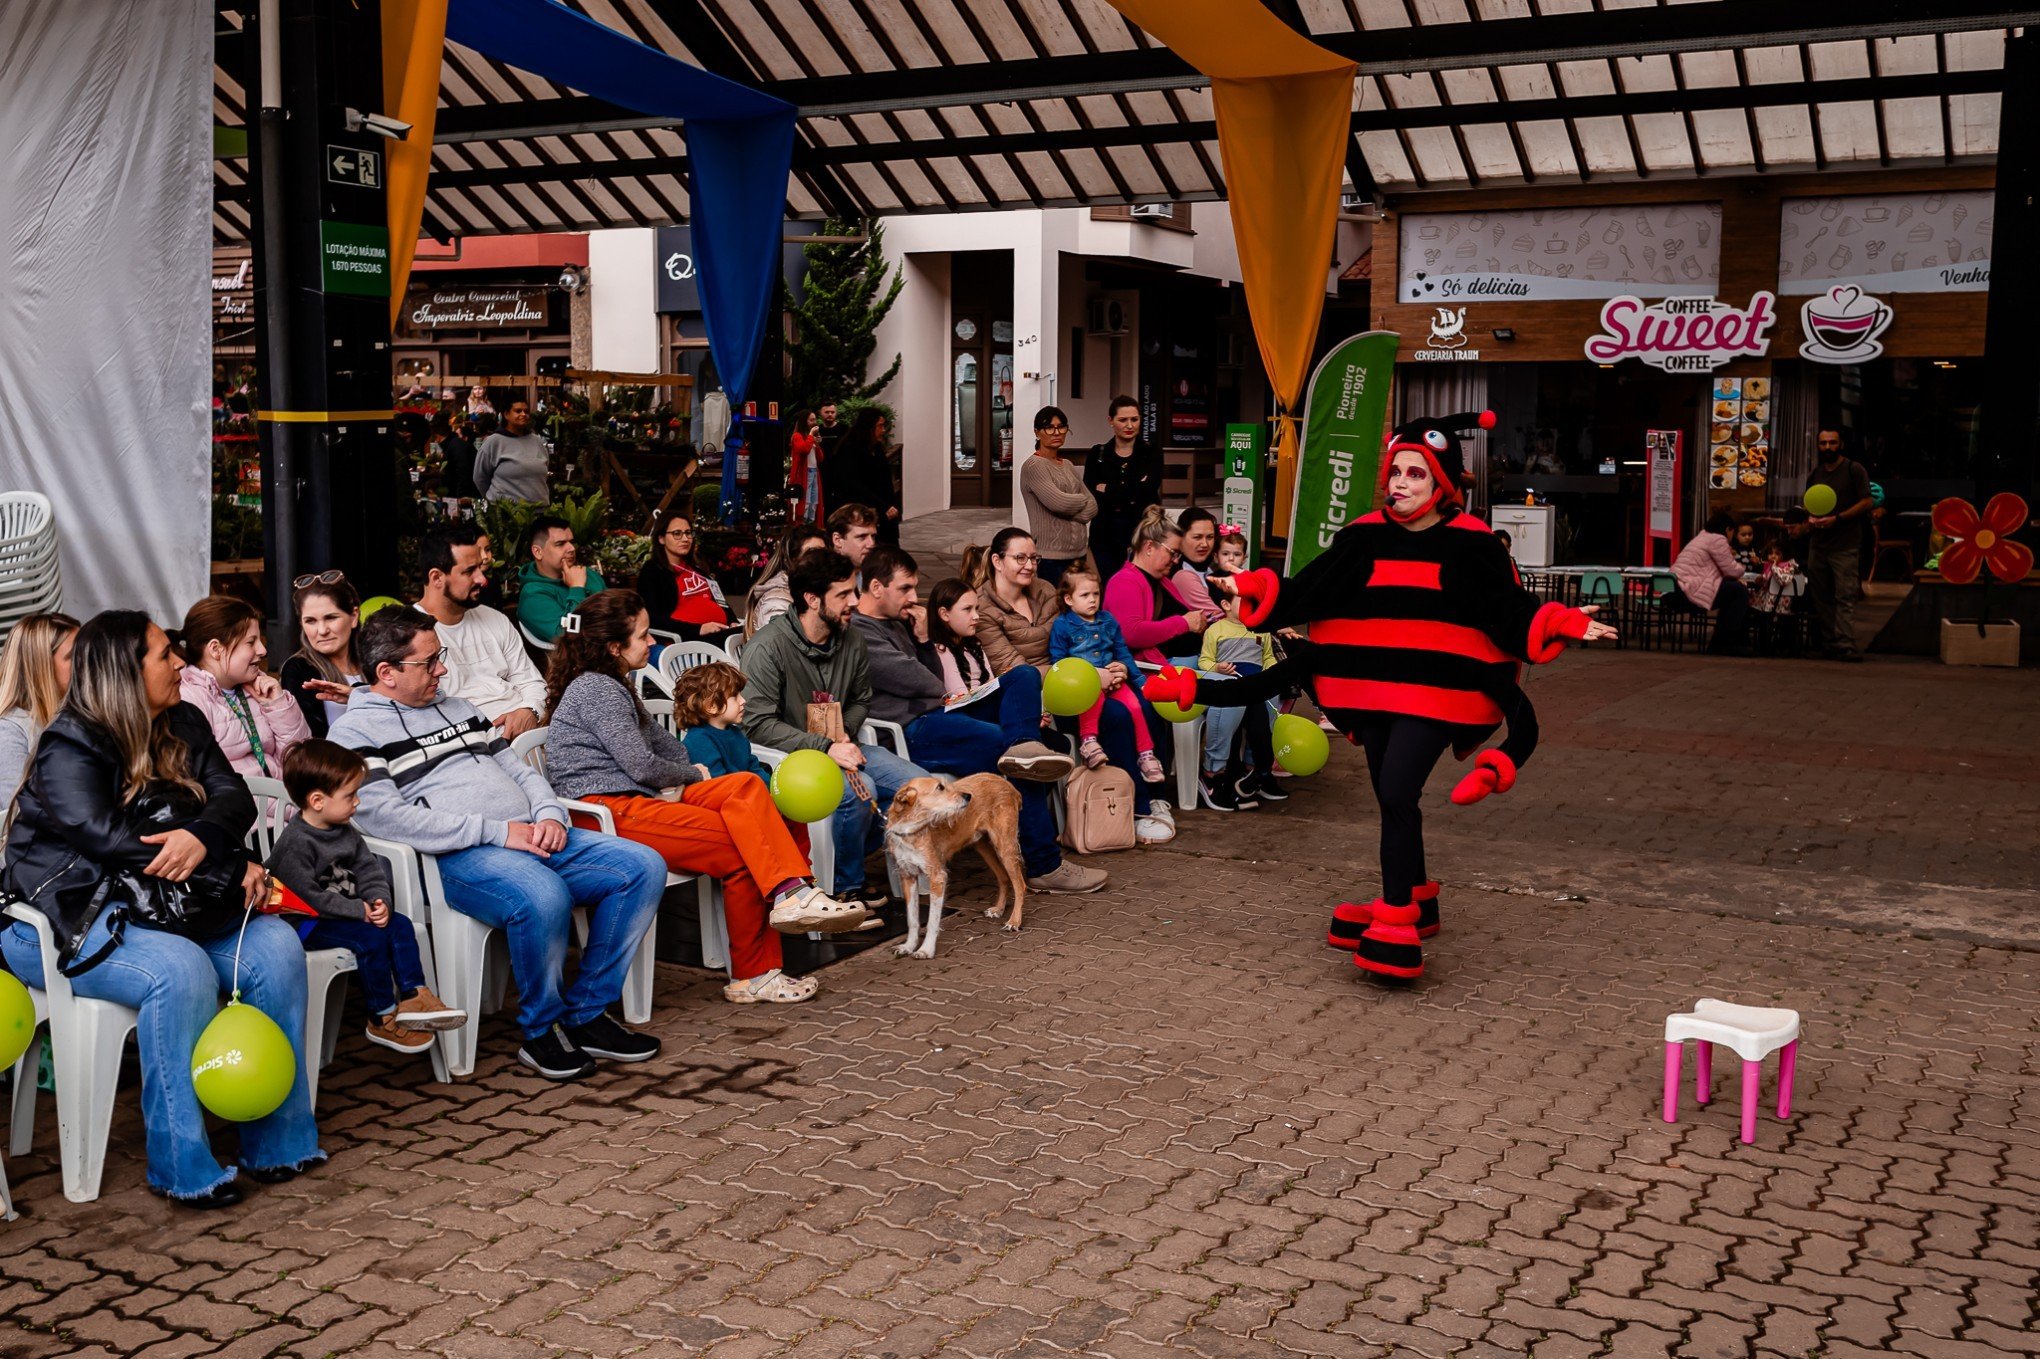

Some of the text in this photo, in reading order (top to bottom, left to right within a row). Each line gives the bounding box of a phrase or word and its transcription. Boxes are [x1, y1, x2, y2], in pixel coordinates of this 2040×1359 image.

[325, 244, 387, 258] LOTAÇÃO MÁXIMA
[350, 262, 382, 274] PESSOAS
[1442, 277, 1530, 297] Só delicias
[412, 300, 542, 328] Imperatriz Leopoldina
[1666, 299, 1711, 314] COFFEE
[1590, 297, 1769, 359] Sweet
[1018, 334, 1037, 347] 340
[1414, 350, 1479, 361] CERVEJARIA TRAUM
[1665, 355, 1710, 370] COFFEE
[1337, 364, 1355, 420] Pioneira
[1348, 367, 1367, 420] desde 1902
[1230, 441, 1251, 450] AQUI
[1318, 450, 1354, 549] Sicredi
